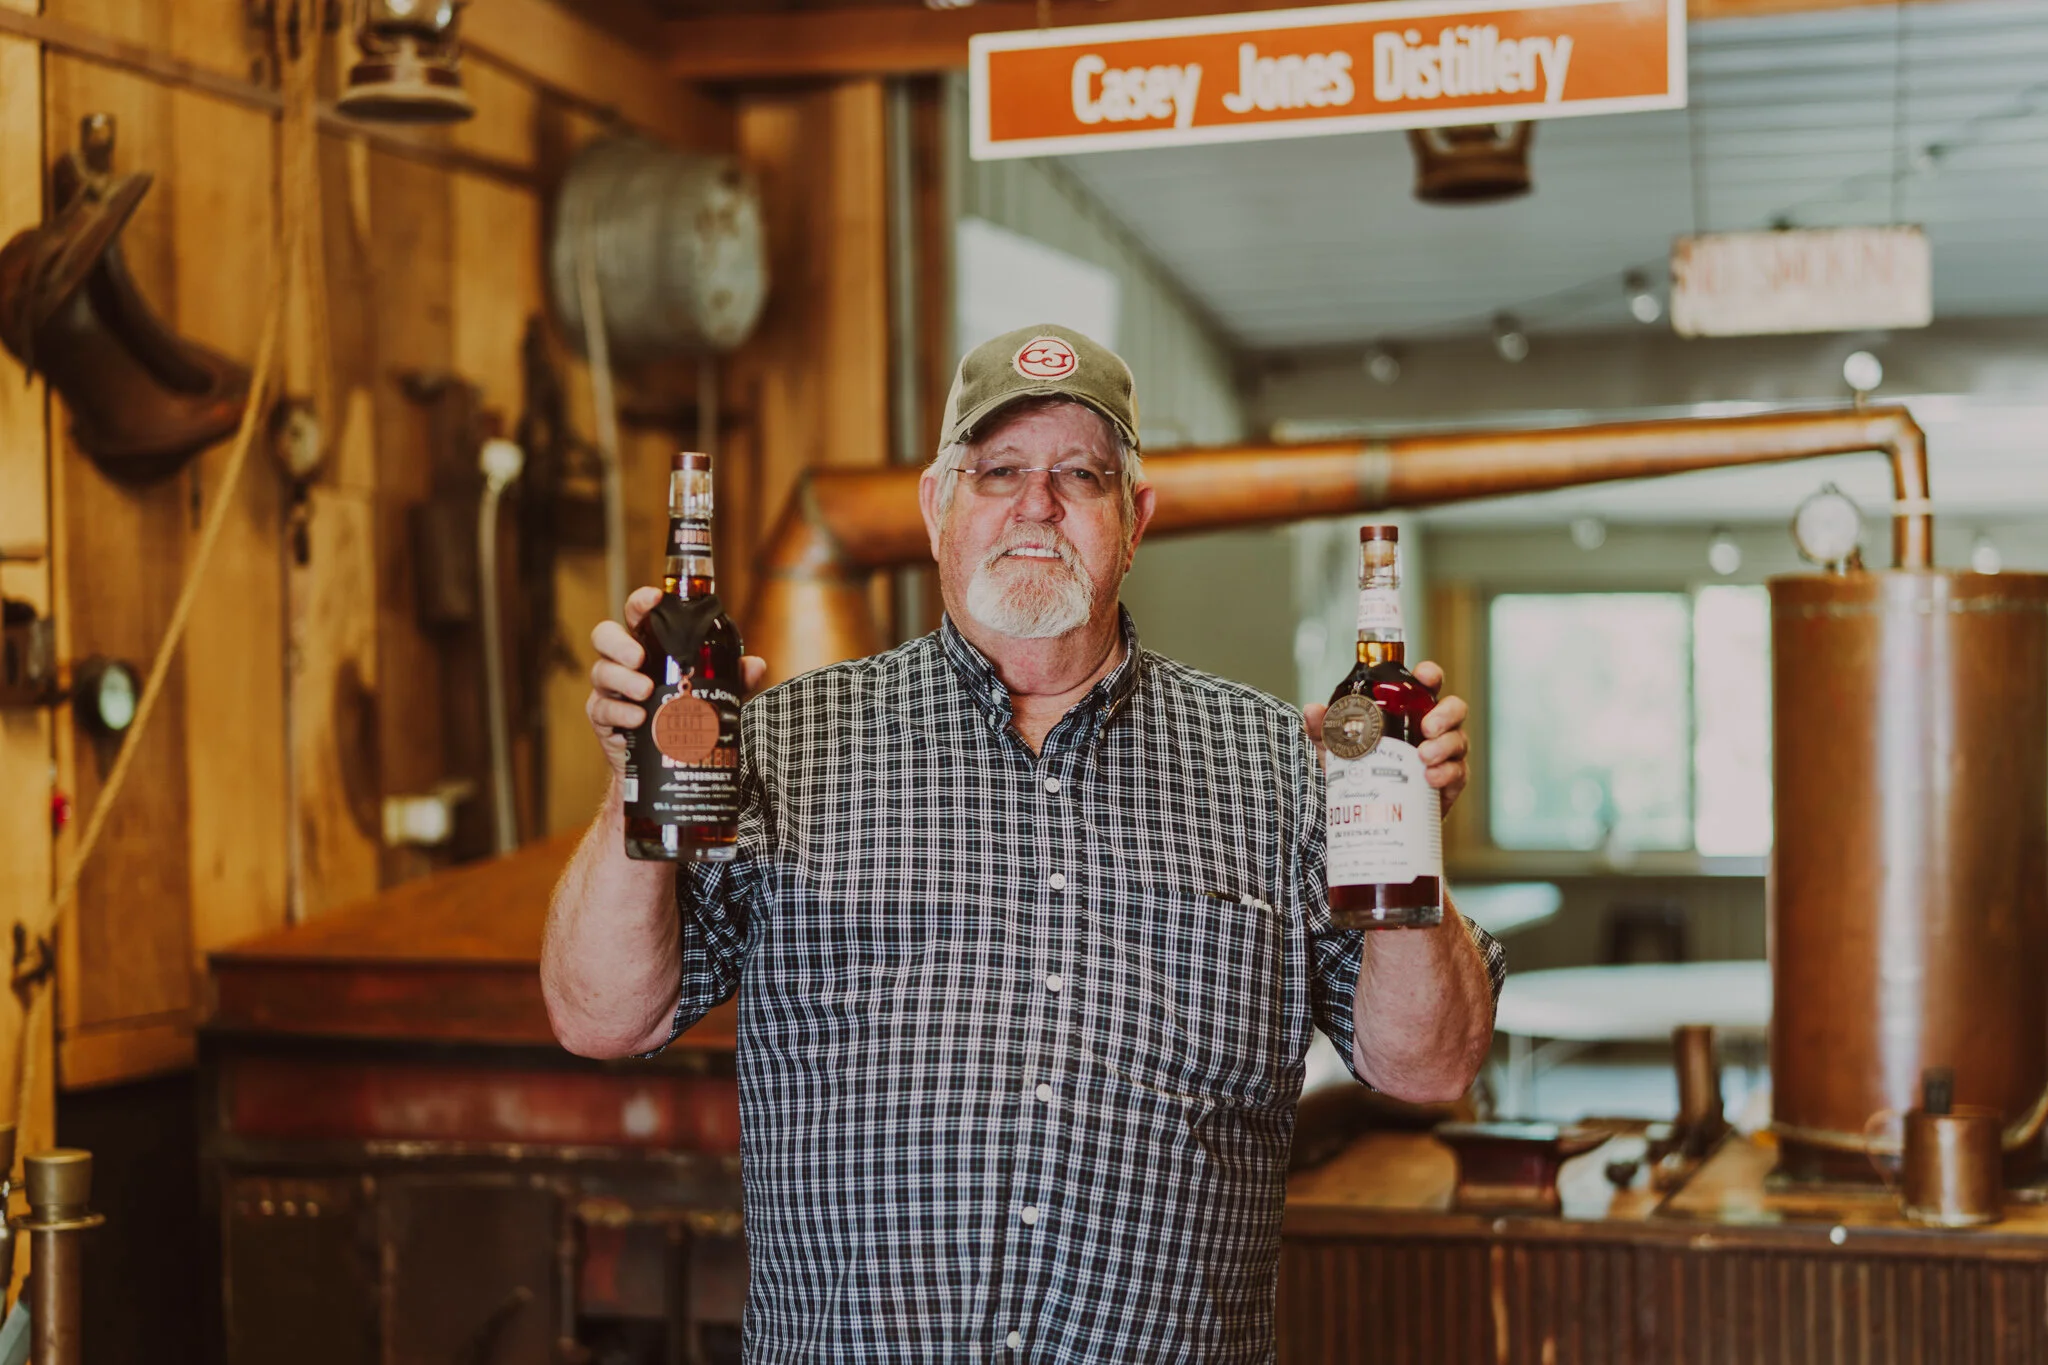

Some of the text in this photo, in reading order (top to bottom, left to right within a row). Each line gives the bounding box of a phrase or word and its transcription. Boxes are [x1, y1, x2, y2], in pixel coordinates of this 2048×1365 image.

[1071, 26, 1574, 128] Casey Jones Distillery
[674, 771, 732, 781] WHISKEY
